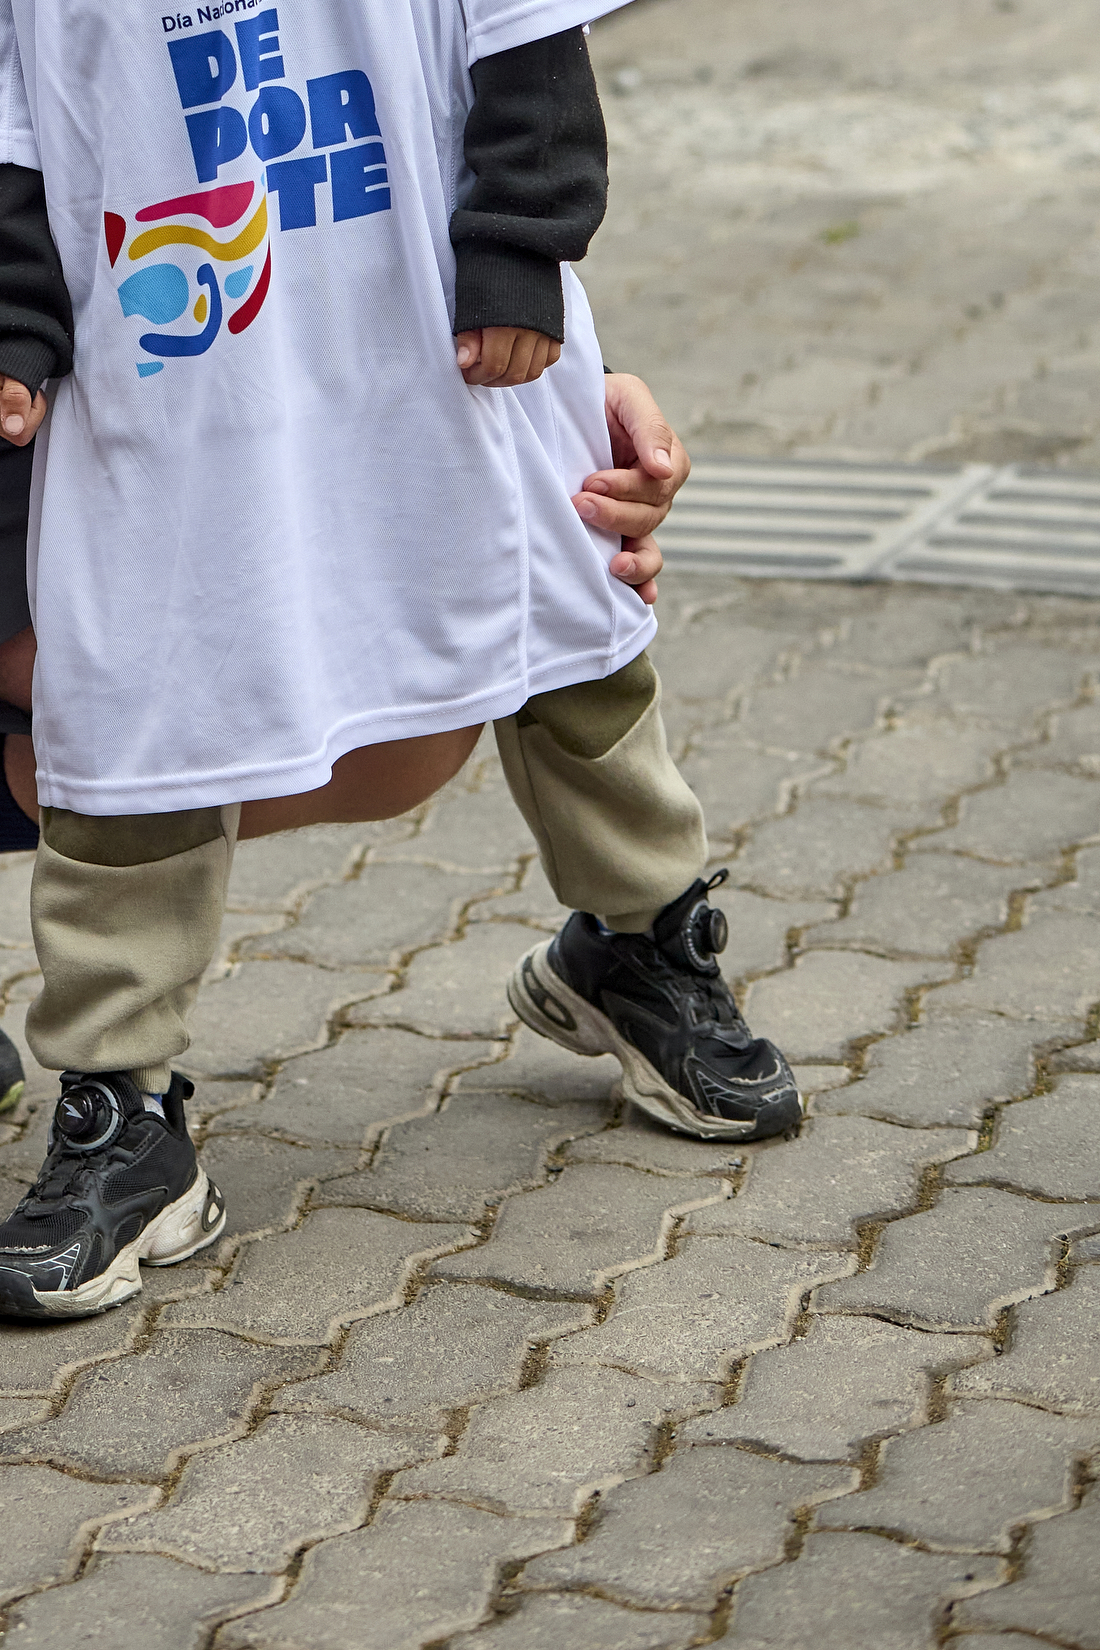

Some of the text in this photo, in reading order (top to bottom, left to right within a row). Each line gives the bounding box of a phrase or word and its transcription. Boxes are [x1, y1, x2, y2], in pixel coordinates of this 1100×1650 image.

[162, 13, 193, 32] Día
[167, 8, 285, 109] DE
[184, 70, 382, 183] POR
[266, 142, 391, 231] TE
